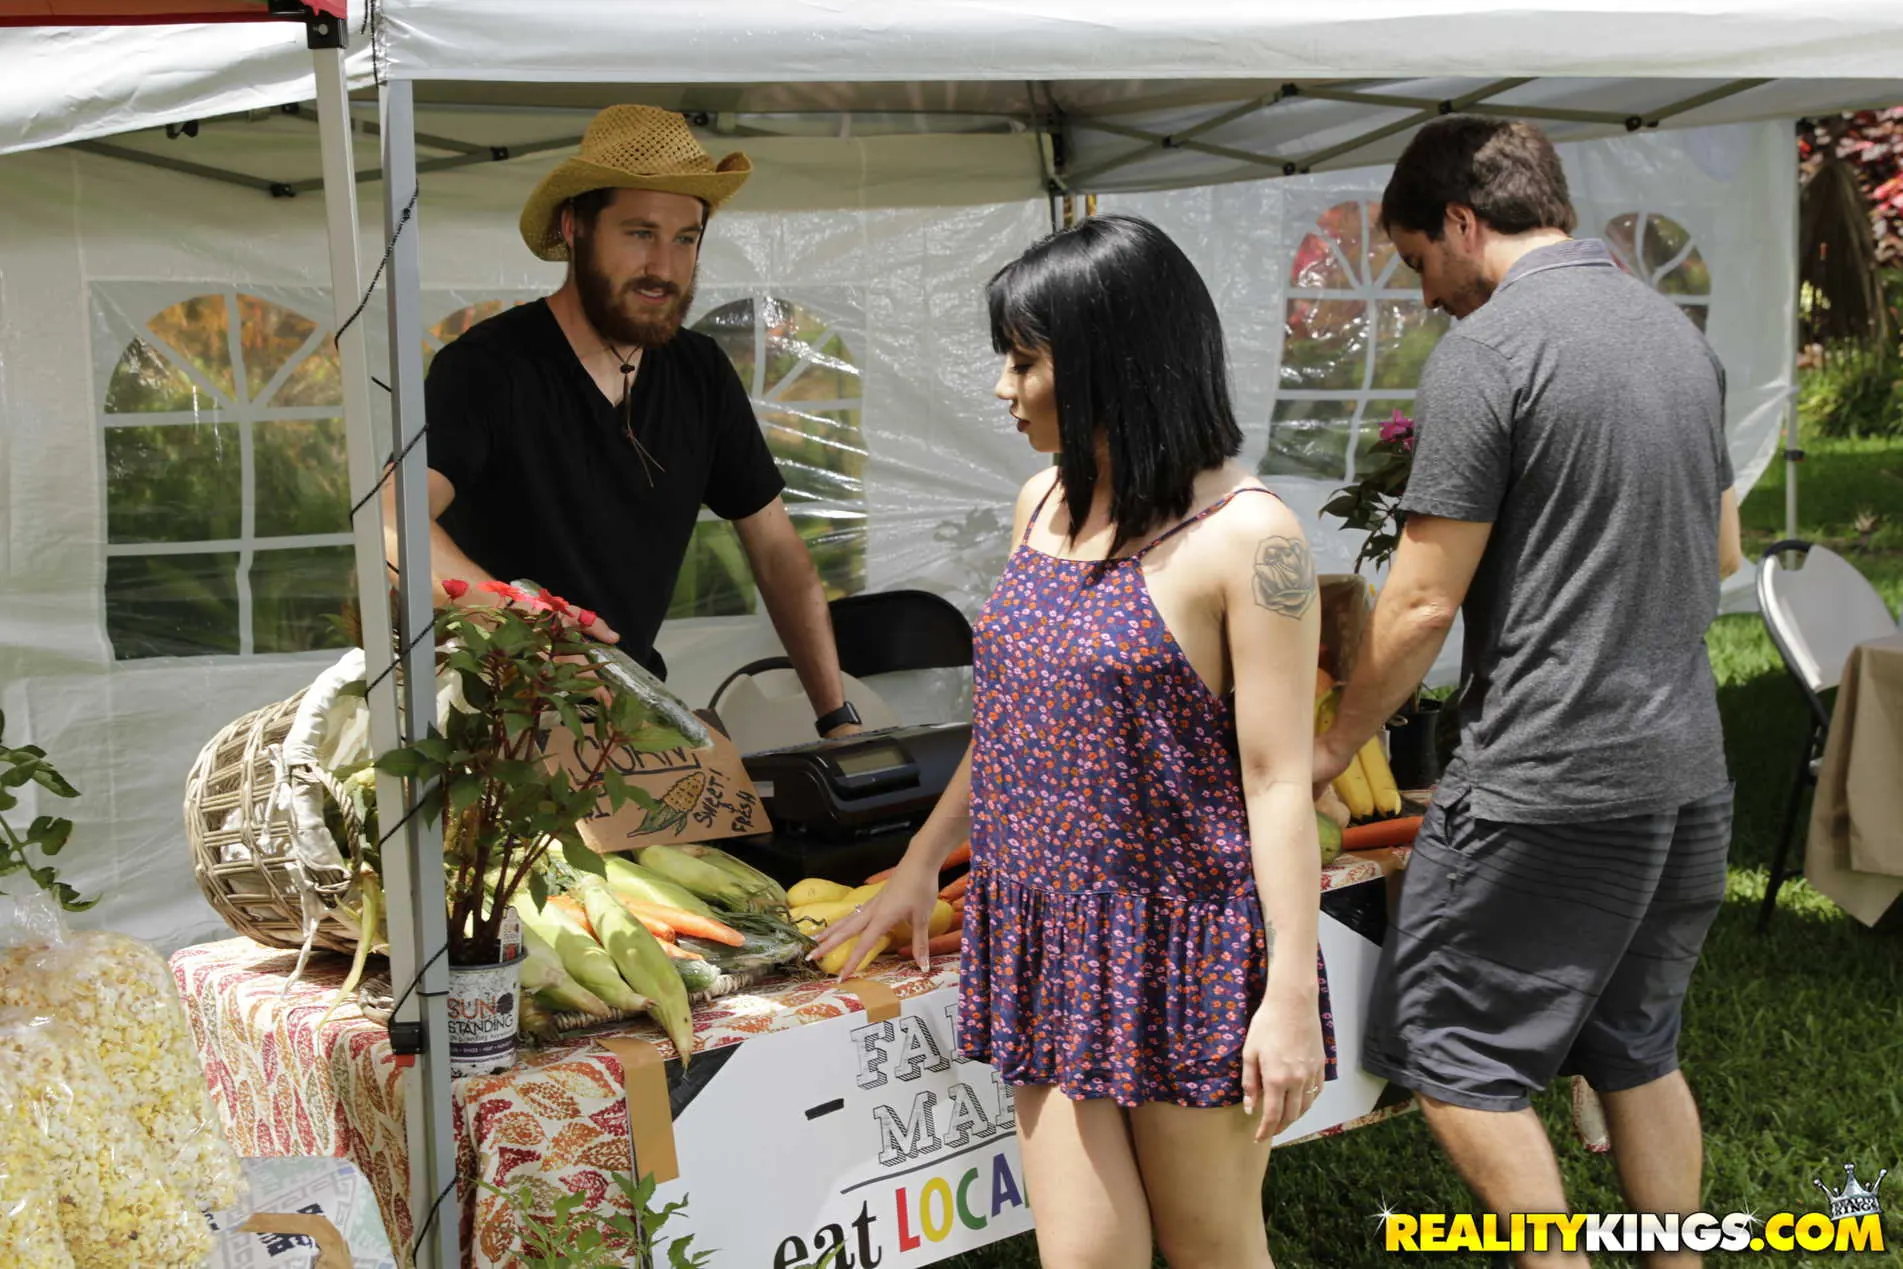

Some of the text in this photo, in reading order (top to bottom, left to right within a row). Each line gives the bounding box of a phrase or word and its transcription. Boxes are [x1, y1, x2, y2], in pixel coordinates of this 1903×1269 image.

[447, 995, 497, 1019] SUN
[850, 1002, 975, 1090] FA
[773, 1153, 1030, 1269] eat LOCA
